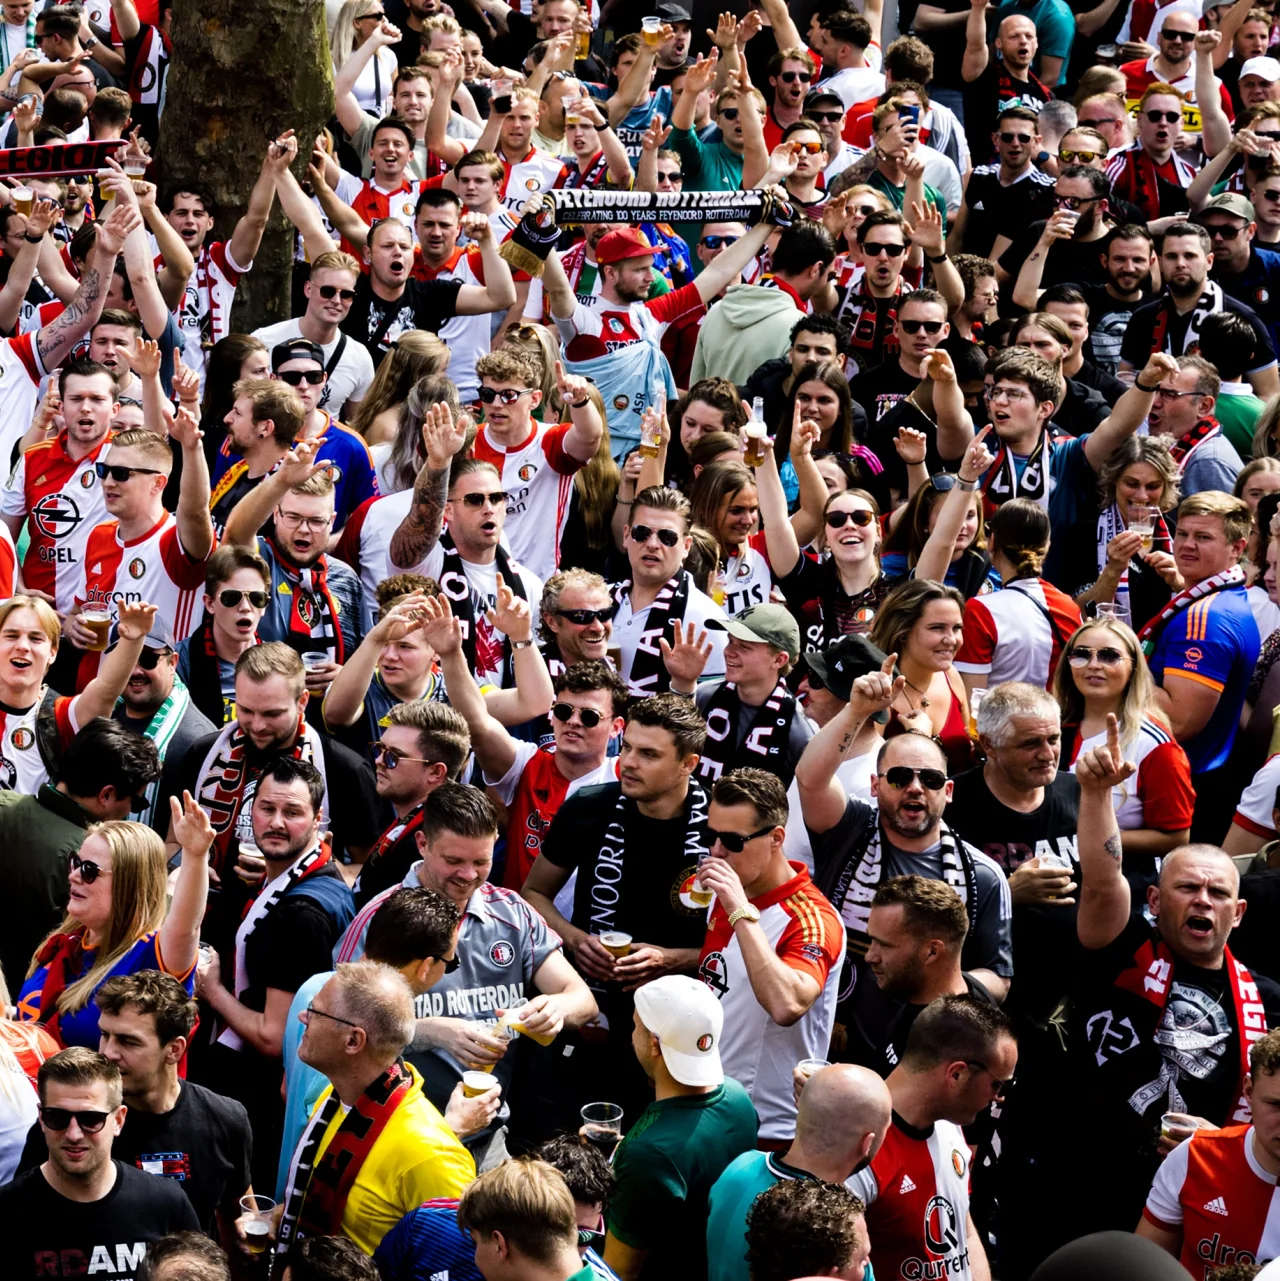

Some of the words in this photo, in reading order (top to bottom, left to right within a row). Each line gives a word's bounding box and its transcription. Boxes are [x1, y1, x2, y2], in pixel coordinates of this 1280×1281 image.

[554, 189, 646, 211] FEYENOORD
[561, 210, 613, 222] CELEBRATING
[615, 210, 628, 221] 100
[630, 210, 654, 221] YEARS
[657, 209, 704, 221] FEYENOORD
[705, 207, 751, 221] ROTTERDAM
[40, 546, 78, 564] OPEL
